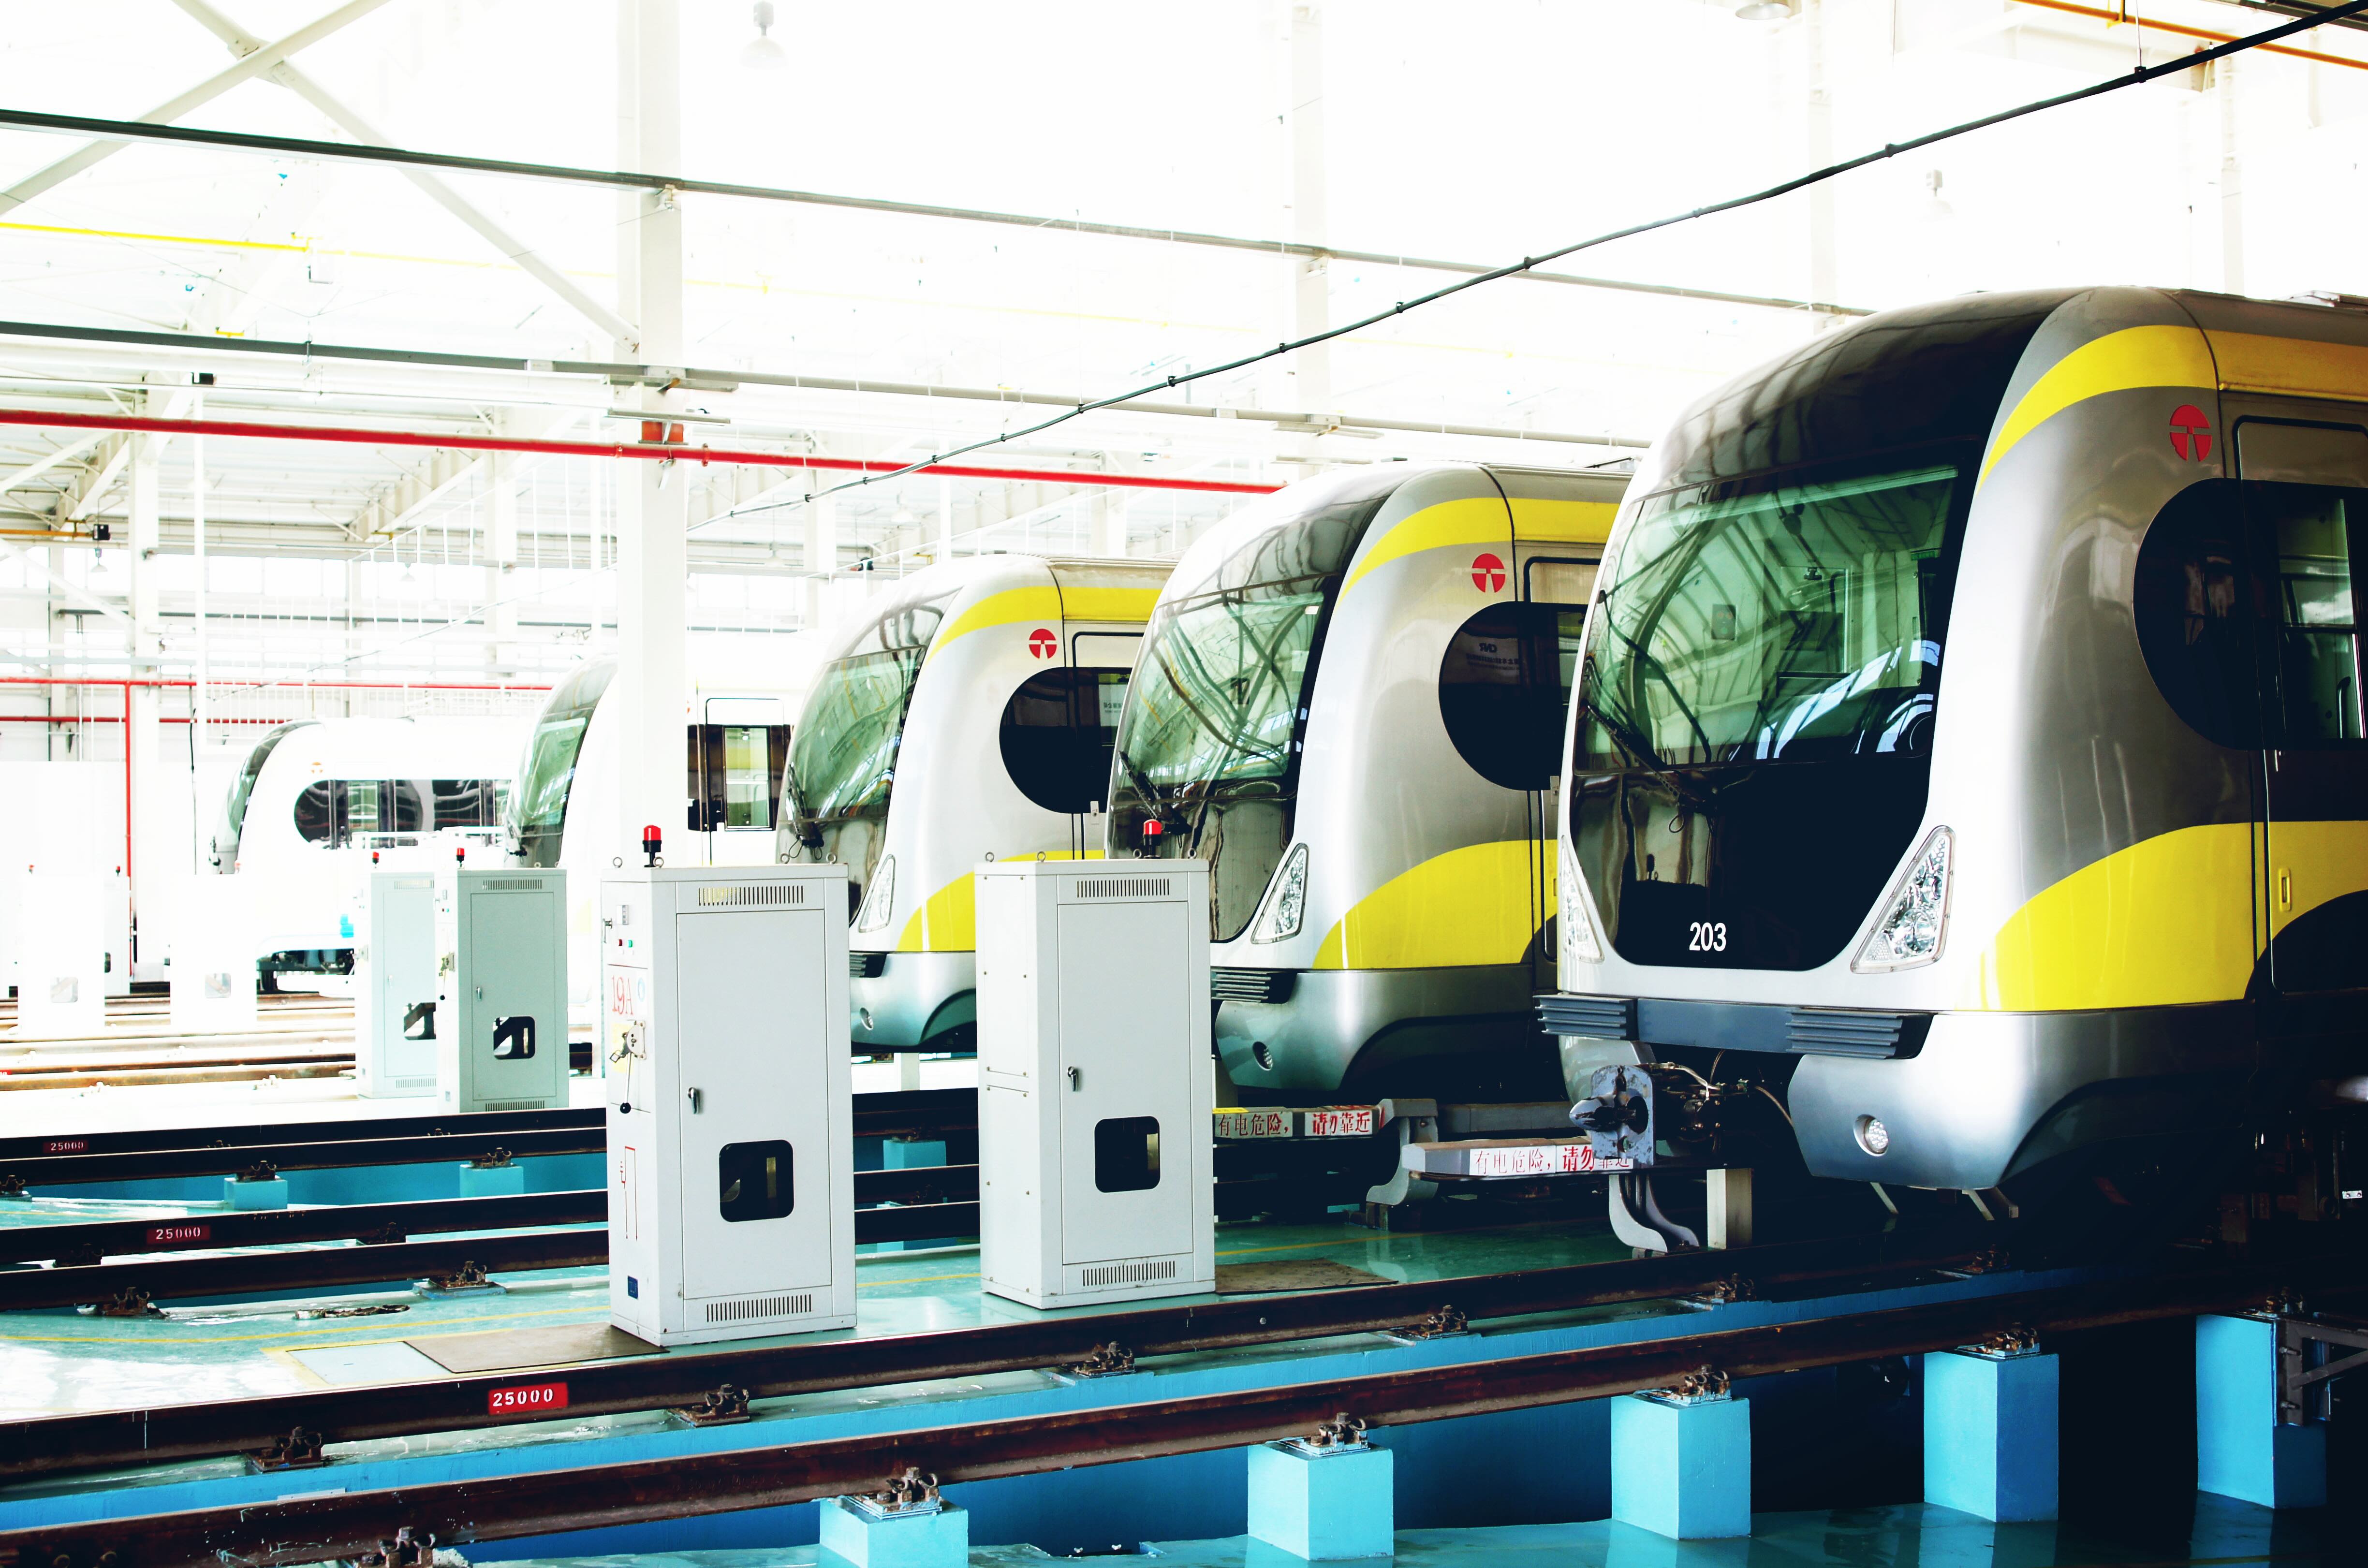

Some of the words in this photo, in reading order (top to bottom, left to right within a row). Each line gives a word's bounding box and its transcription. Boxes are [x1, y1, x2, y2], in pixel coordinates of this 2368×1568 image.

[1689, 922, 1726, 952] 203
[611, 974, 634, 1016] 19A
[50, 1142, 84, 1151] 25000
[155, 1227, 201, 1240] 25000
[492, 1388, 554, 1407] 25000
